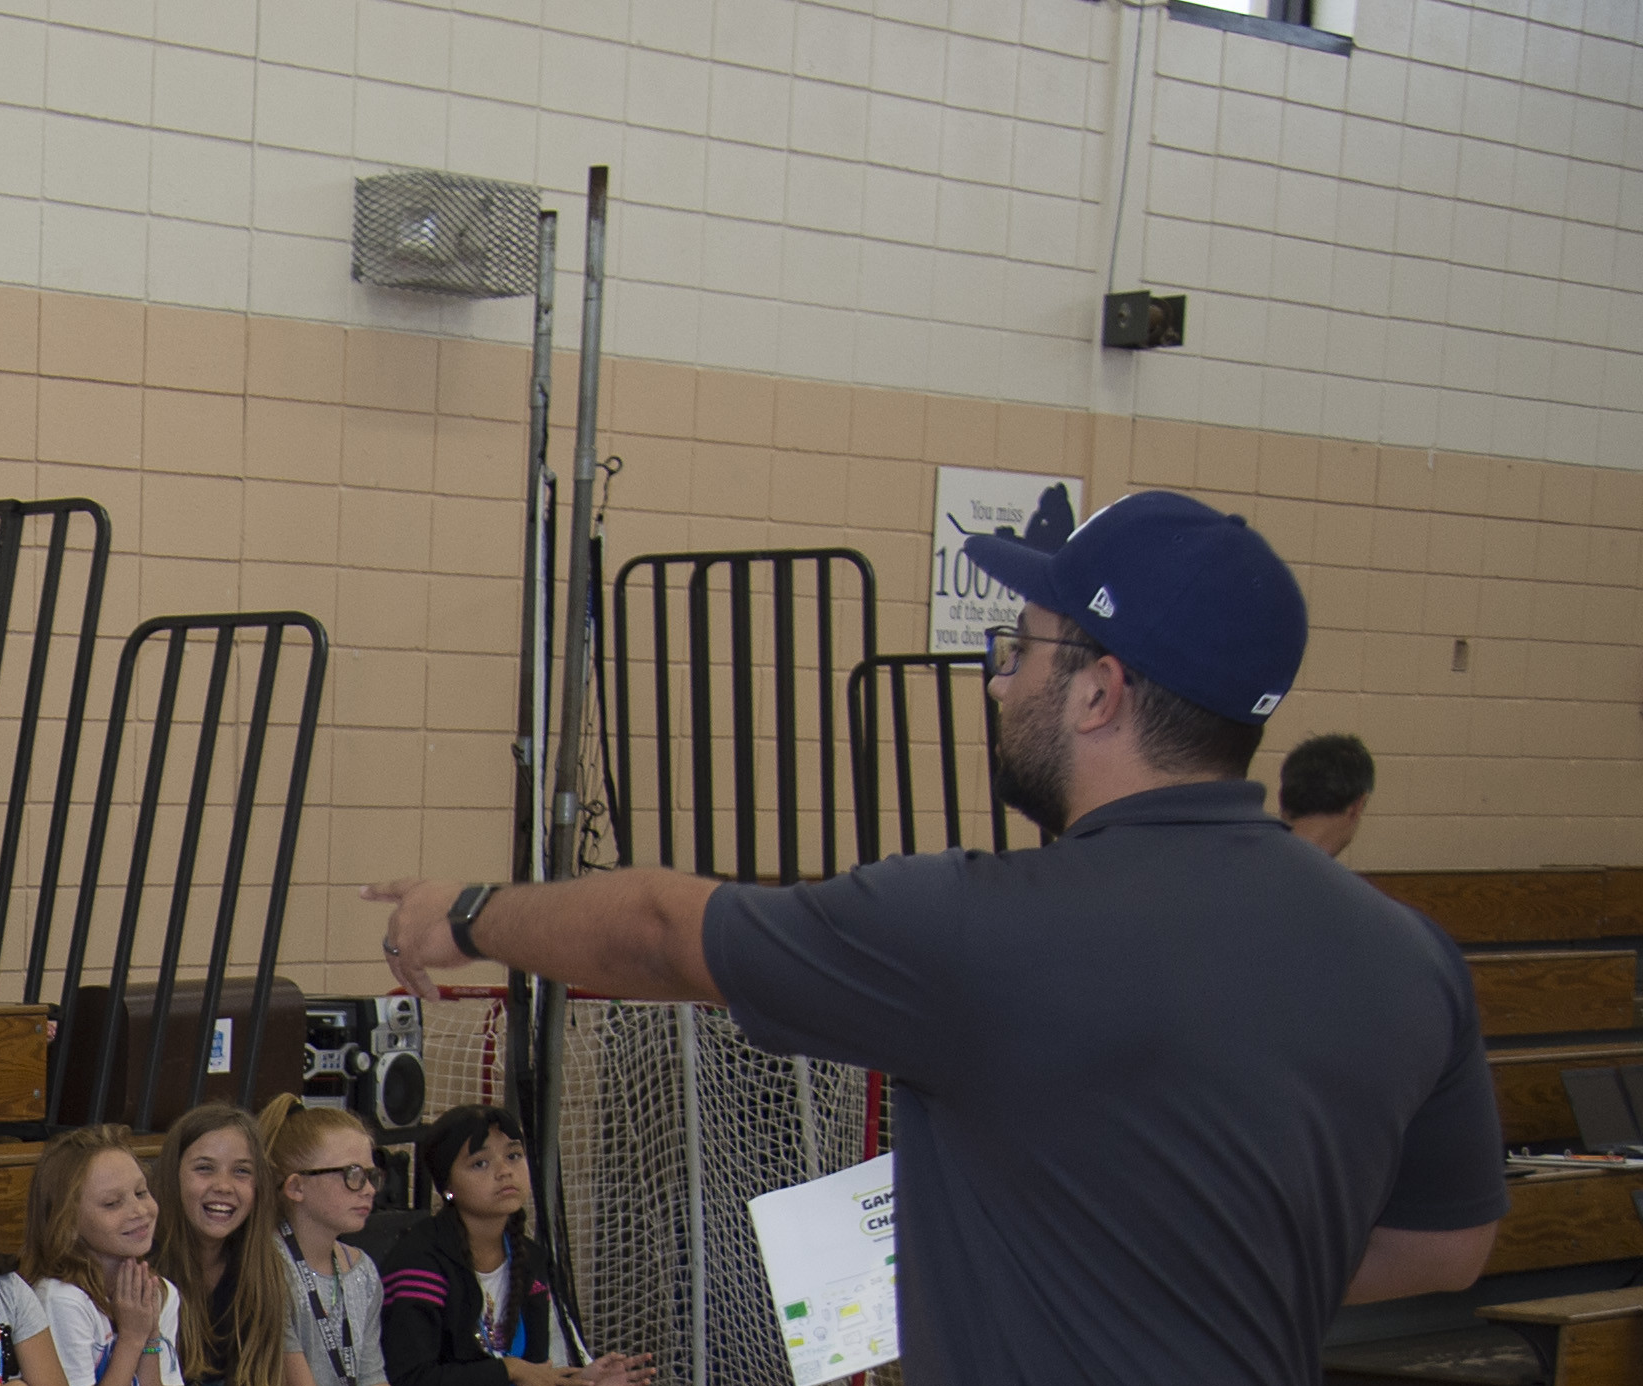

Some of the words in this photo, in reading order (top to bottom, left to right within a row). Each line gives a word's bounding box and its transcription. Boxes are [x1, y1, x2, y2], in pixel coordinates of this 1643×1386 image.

[970, 500, 993, 521] You
[996, 503, 1024, 522] miss
[949, 601, 963, 621] of
[964, 602, 984, 622] the
[935, 629, 959, 650] you
